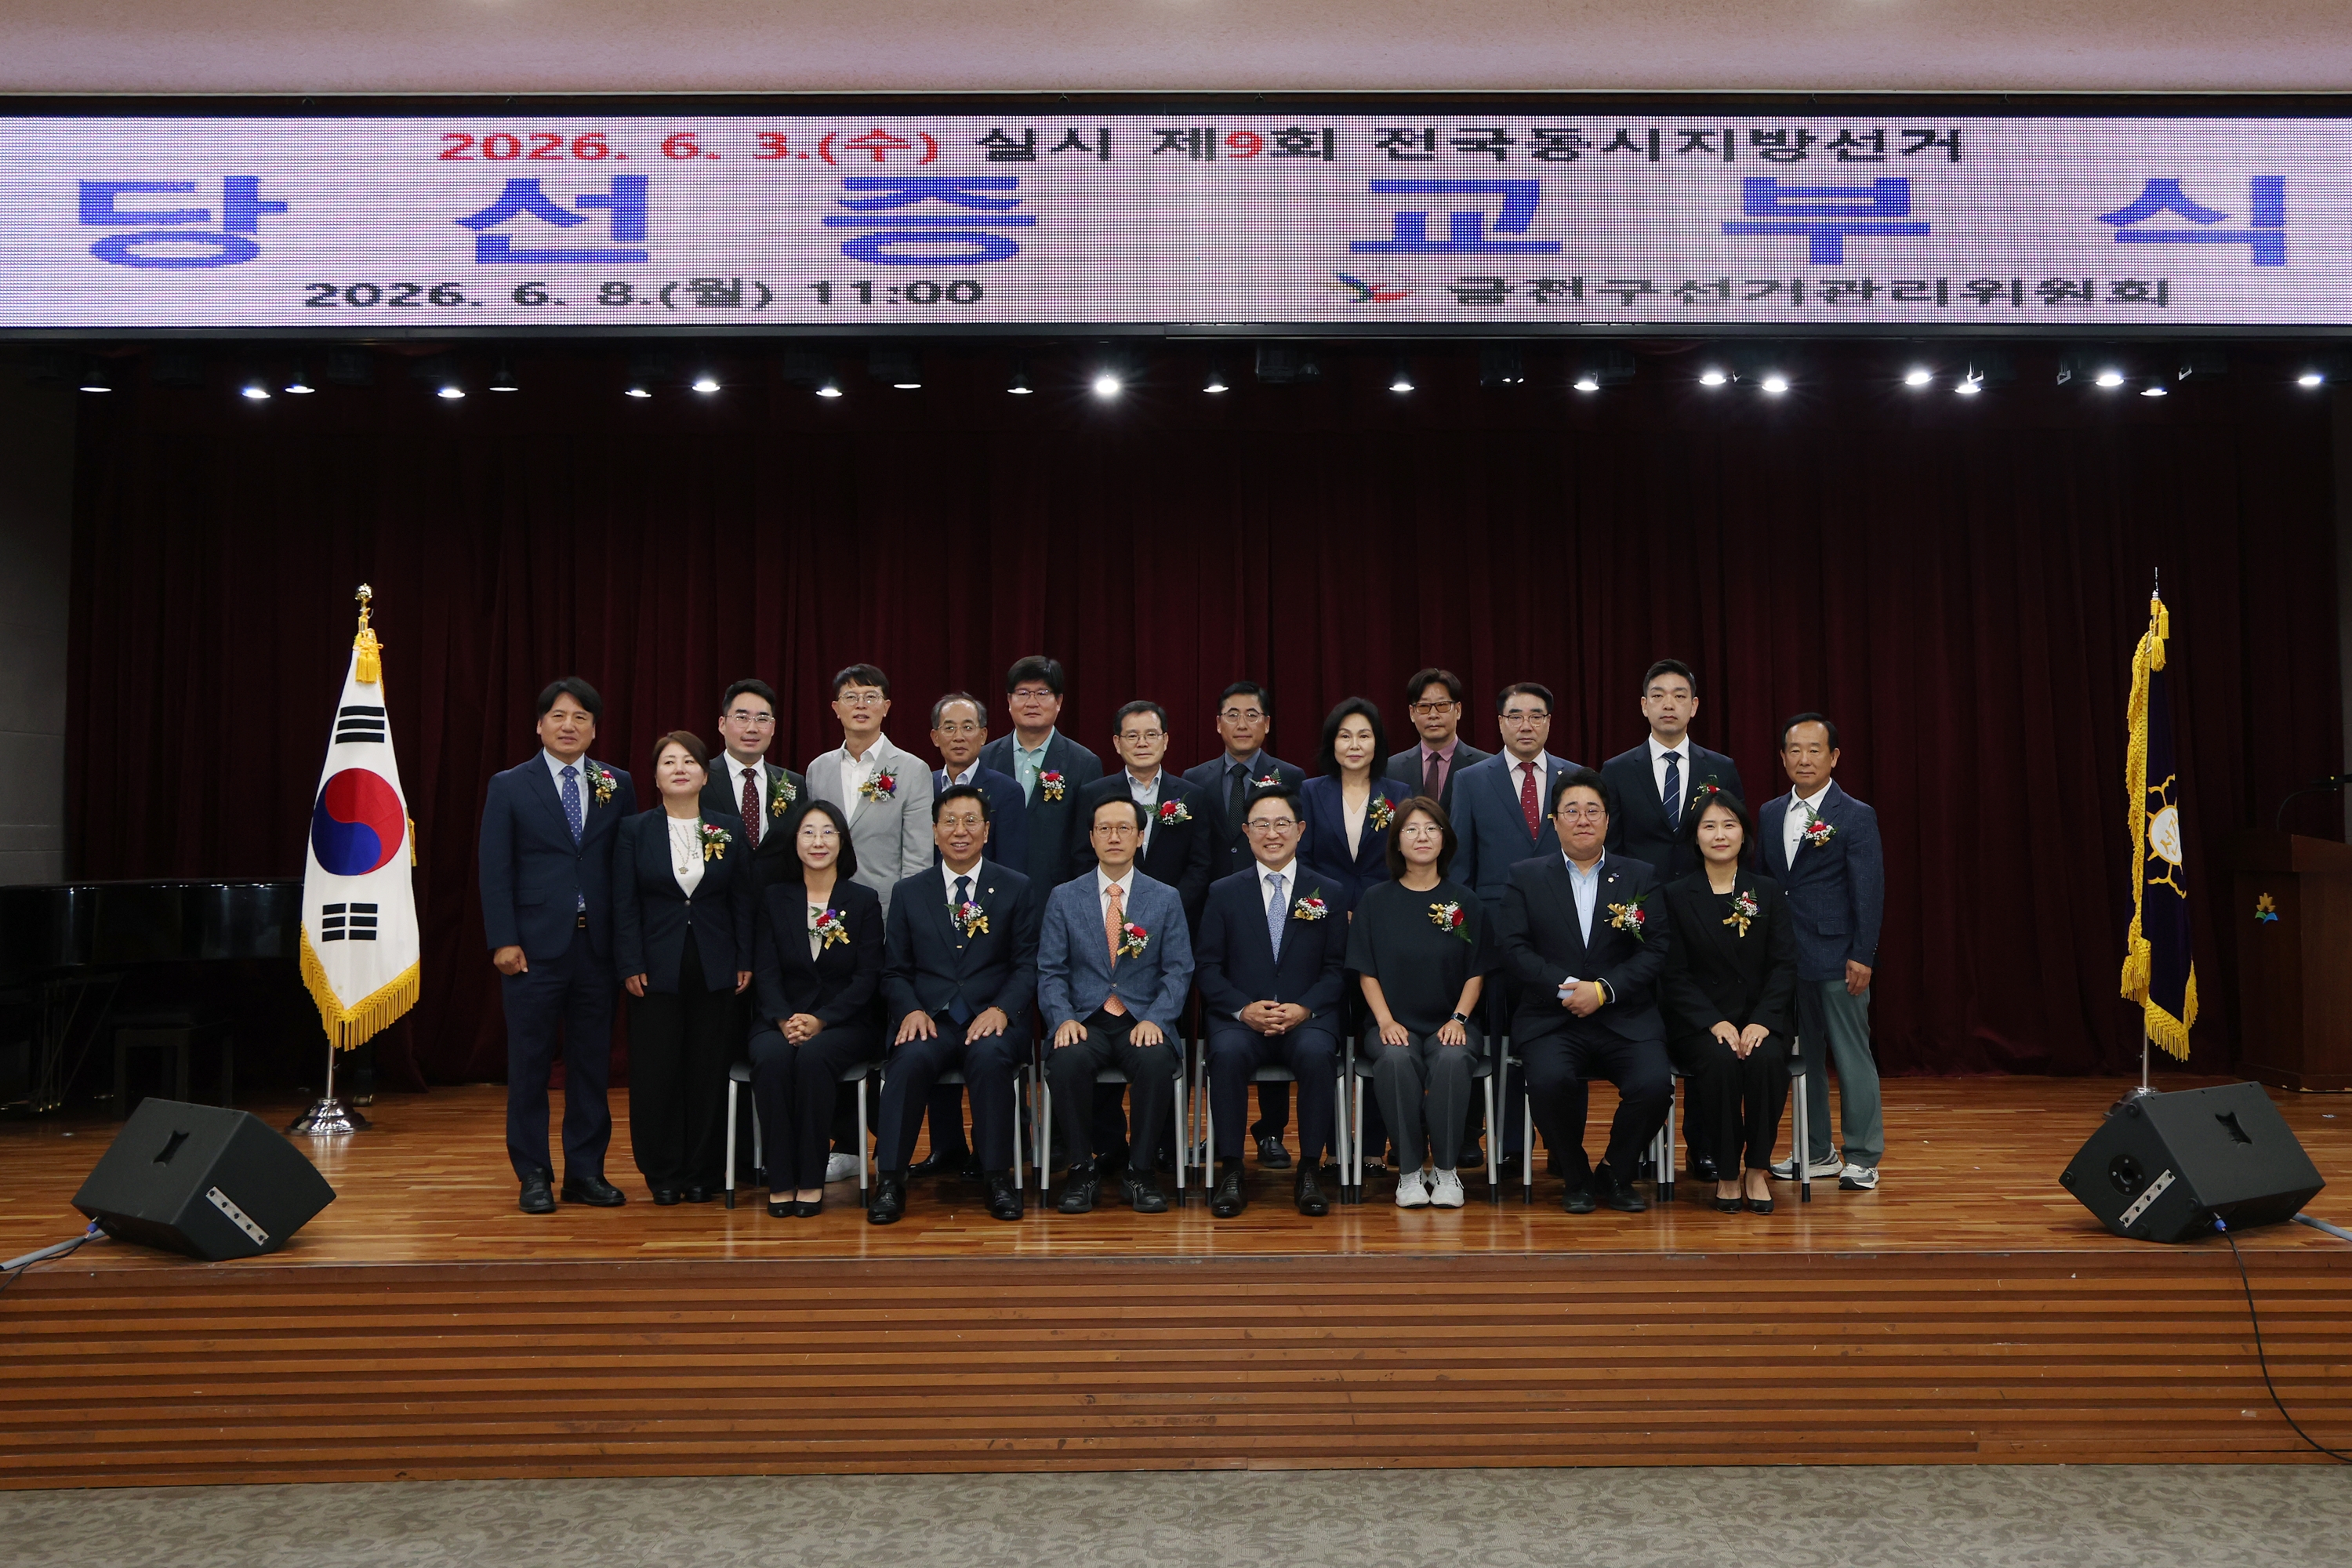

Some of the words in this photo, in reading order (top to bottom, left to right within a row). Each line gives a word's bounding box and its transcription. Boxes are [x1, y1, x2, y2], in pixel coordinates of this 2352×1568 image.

[440, 132, 626, 160] 2026.
[662, 132, 720, 159] 6.
[756, 129, 938, 165] 3.(수)
[978, 128, 1110, 162] 실시
[1154, 127, 1334, 161] 제9회
[1377, 128, 1960, 162] 전국동시지방선거
[306, 283, 480, 307] 2026.
[513, 282, 564, 306] 6.
[597, 278, 773, 310] 8.(월)
[812, 281, 983, 304] 11:00
